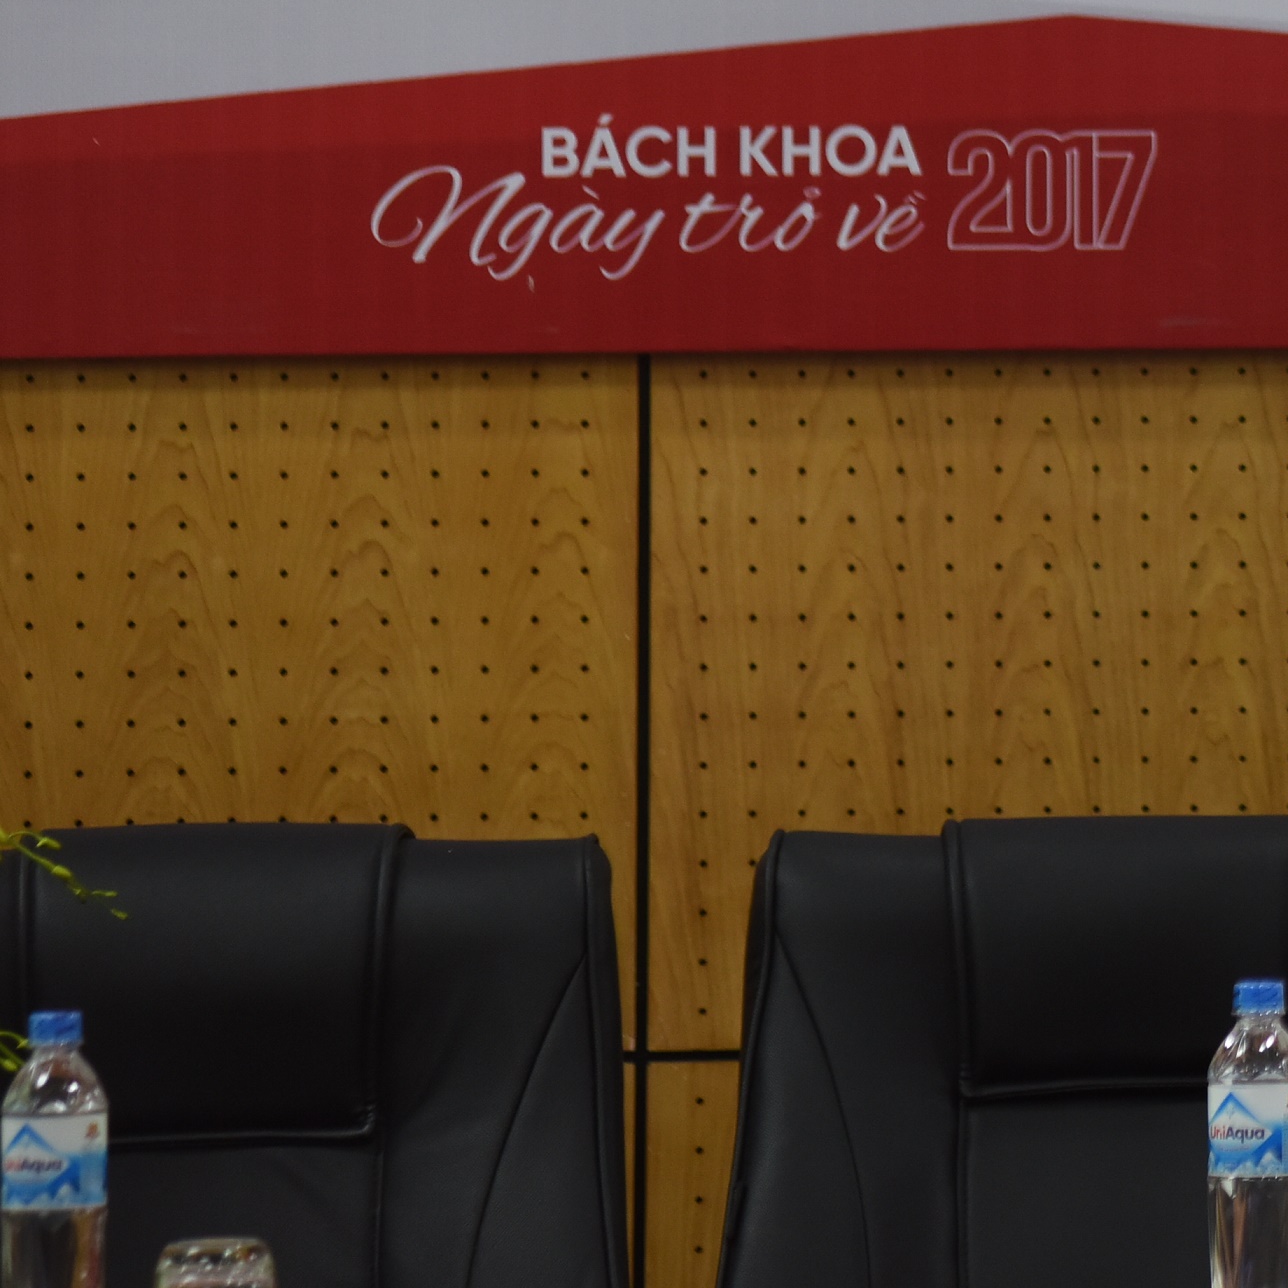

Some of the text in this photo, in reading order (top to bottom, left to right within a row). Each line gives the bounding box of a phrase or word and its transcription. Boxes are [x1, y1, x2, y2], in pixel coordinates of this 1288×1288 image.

[541, 114, 922, 178] BÁCH KHOA
[370, 128, 1158, 292] Ngày trở về 2017
[1210, 1124, 1265, 1144] UniAqua
